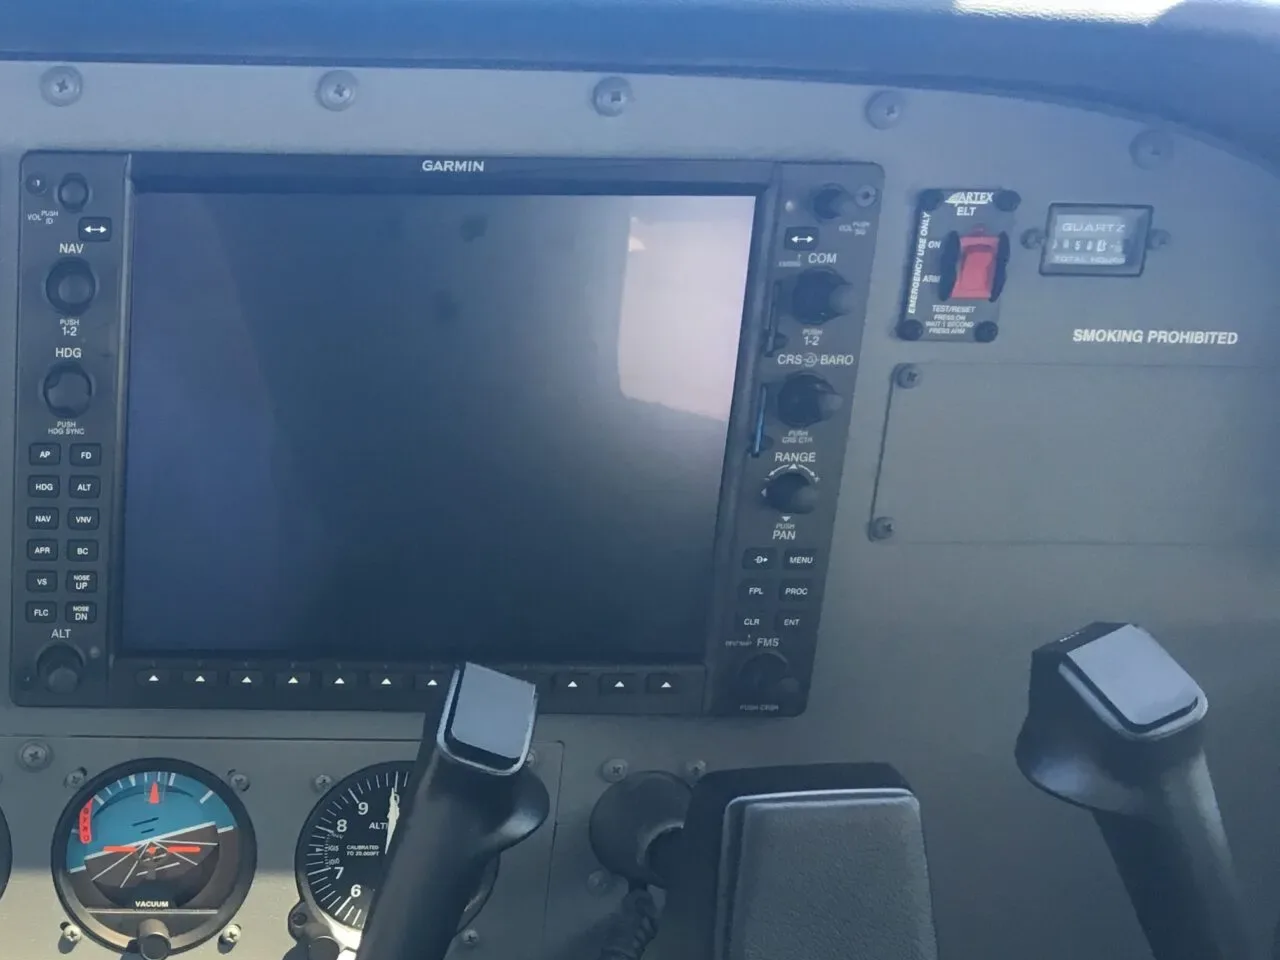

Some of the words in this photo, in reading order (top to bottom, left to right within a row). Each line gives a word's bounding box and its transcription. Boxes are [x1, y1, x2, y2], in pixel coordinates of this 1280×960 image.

[422, 160, 484, 172] GARMIN
[958, 192, 994, 202] ARTEX
[956, 207, 976, 216] ELT
[59, 243, 84, 253] NAV
[808, 253, 837, 264] COM
[1072, 329, 1143, 343] SMOKING
[1147, 331, 1238, 344] PROHIBITED
[55, 348, 82, 358] HDG
[777, 354, 802, 365] CRS
[820, 354, 854, 365] BARO
[774, 452, 816, 463] RANGE
[36, 483, 53, 491] HDG
[772, 530, 796, 540] PAN
[790, 556, 813, 564] MENU
[76, 582, 88, 590] UP
[785, 587, 808, 595] PROC
[75, 613, 87, 621] DN
[51, 629, 71, 638] ALT
[757, 638, 779, 647] FMS
[358, 802, 368, 815] 9
[336, 820, 347, 832] 8
[334, 867, 344, 879] 7
[351, 884, 361, 897] 6
